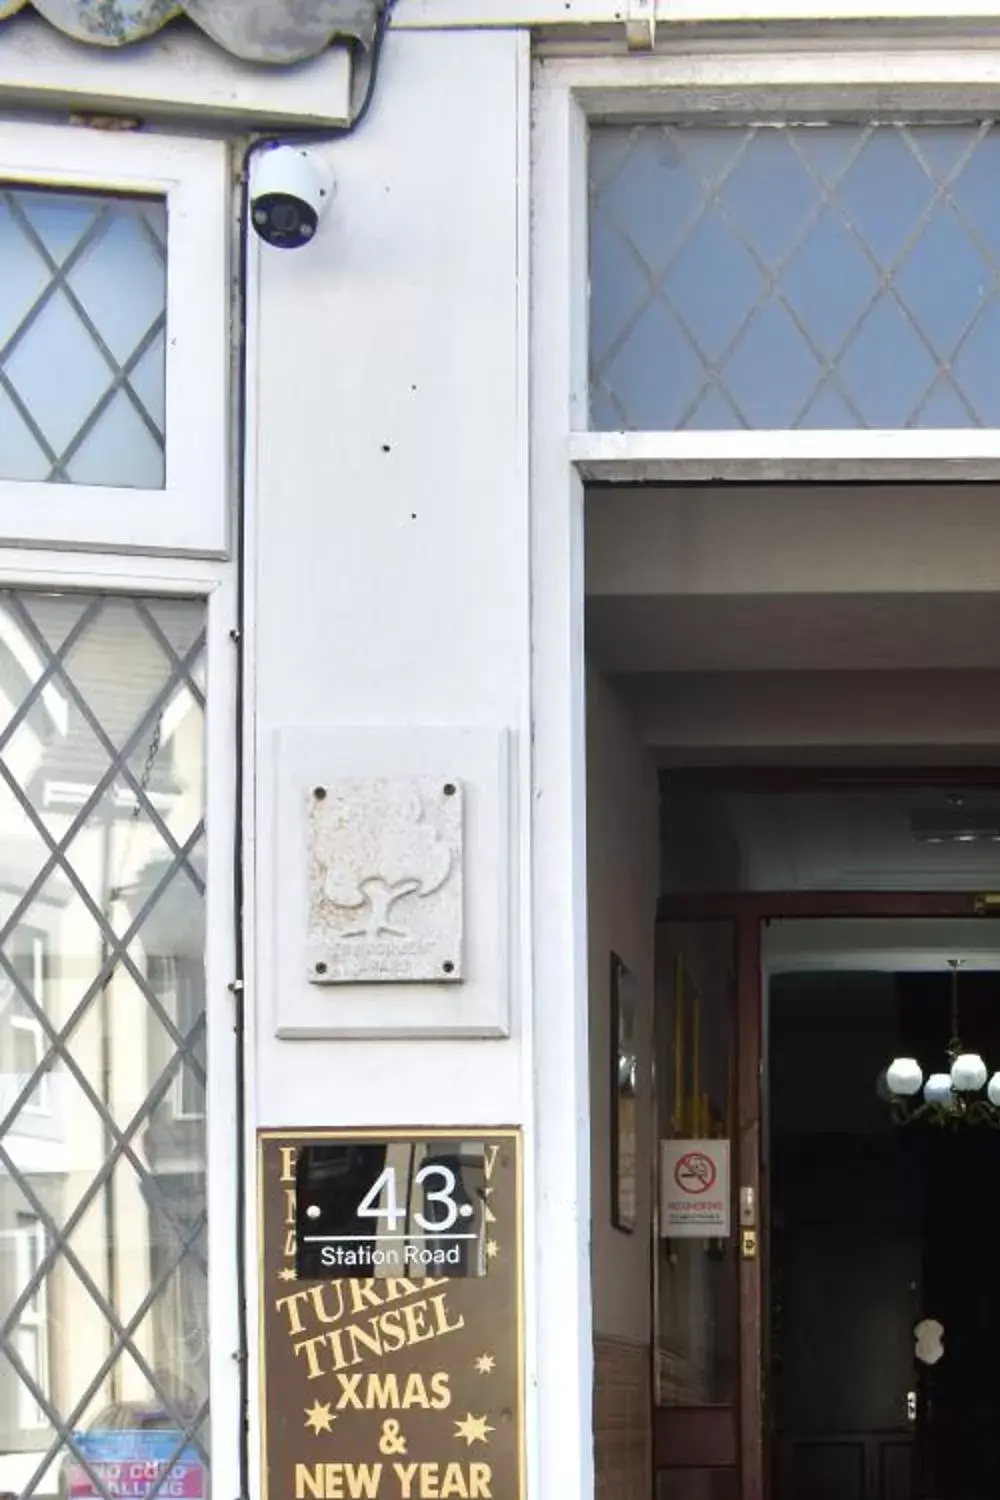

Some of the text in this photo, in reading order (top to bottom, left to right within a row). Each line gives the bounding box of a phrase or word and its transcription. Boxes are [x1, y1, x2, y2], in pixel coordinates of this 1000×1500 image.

[357, 1165, 457, 1231] 43
[321, 1244, 460, 1266] Station Road
[275, 1277, 449, 1335] TURK
[293, 1293, 465, 1379] TINSEL
[336, 1373, 451, 1409] XMAS
[379, 1419, 407, 1455] &
[129, 1462, 187, 1481] COD
[295, 1462, 492, 1499] NEW YEAR
